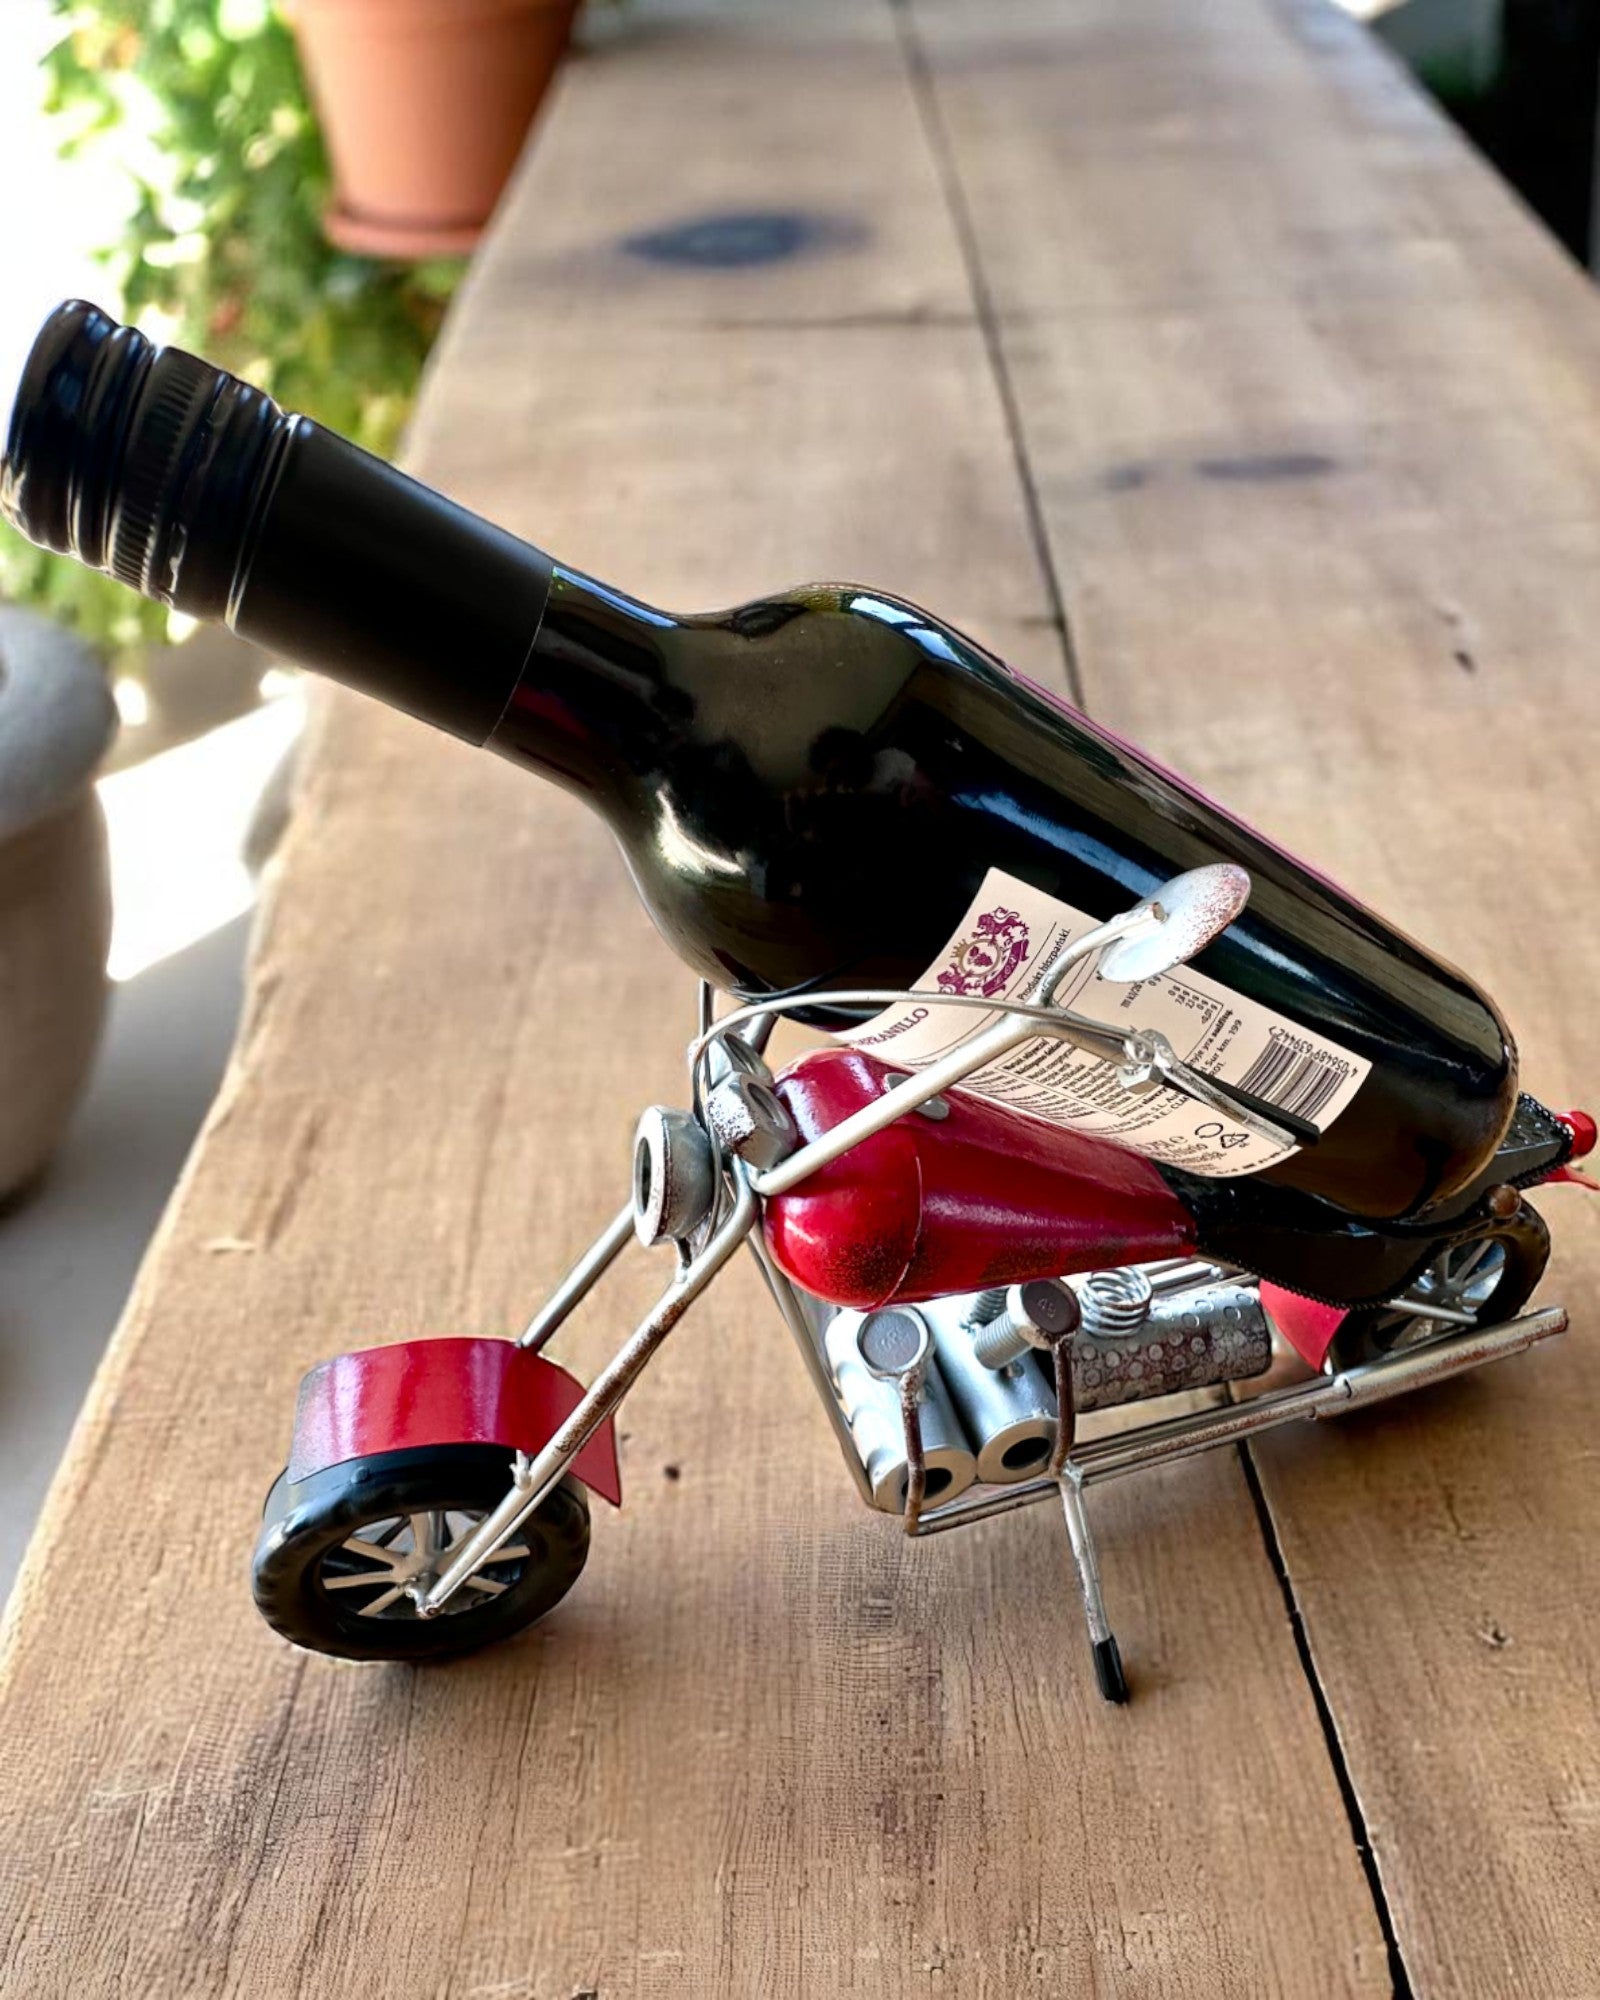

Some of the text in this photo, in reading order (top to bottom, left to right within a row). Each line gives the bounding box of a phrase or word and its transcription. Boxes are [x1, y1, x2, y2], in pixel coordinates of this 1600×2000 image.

[1016, 971, 1043, 1000] Produkt
[1204, 1052, 1219, 1066] Sur
[1228, 1019, 1242, 1035] 199
[1313, 1048, 1350, 1073] 056489
